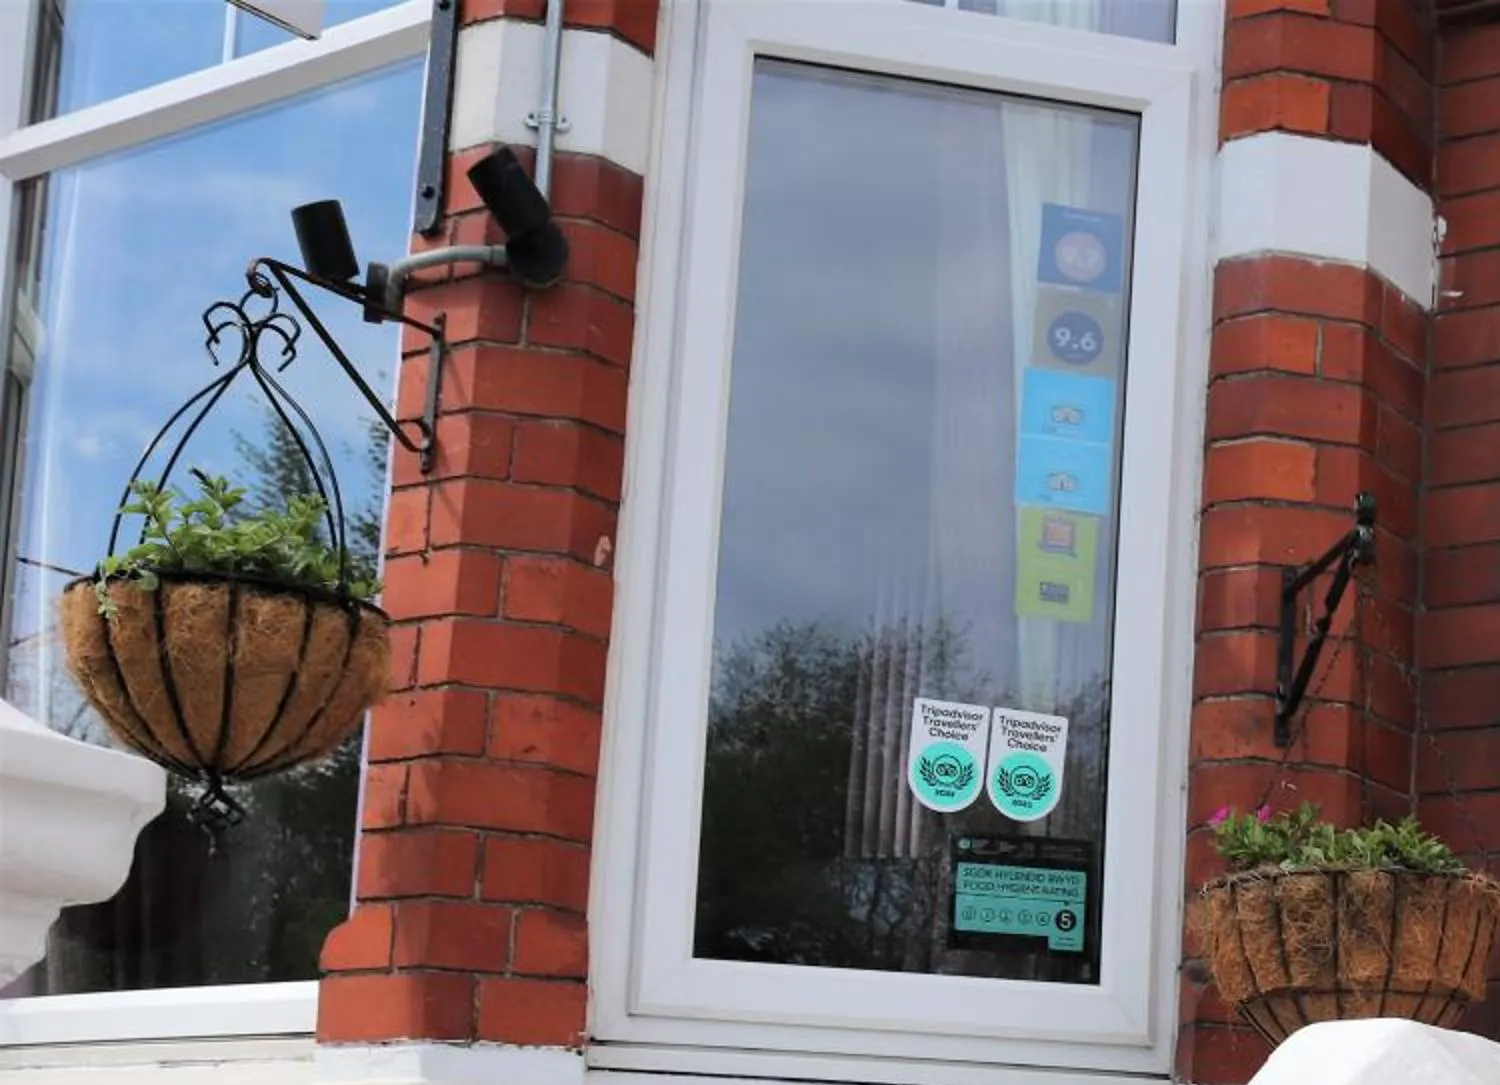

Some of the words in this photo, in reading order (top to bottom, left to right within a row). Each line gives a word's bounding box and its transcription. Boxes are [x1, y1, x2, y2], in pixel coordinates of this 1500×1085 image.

[1054, 326, 1096, 352] 9.6
[921, 703, 984, 721] Tripadvisor
[1000, 714, 1062, 733] Tripadvisor
[929, 727, 969, 741] Choice
[1007, 738, 1048, 753] Choice
